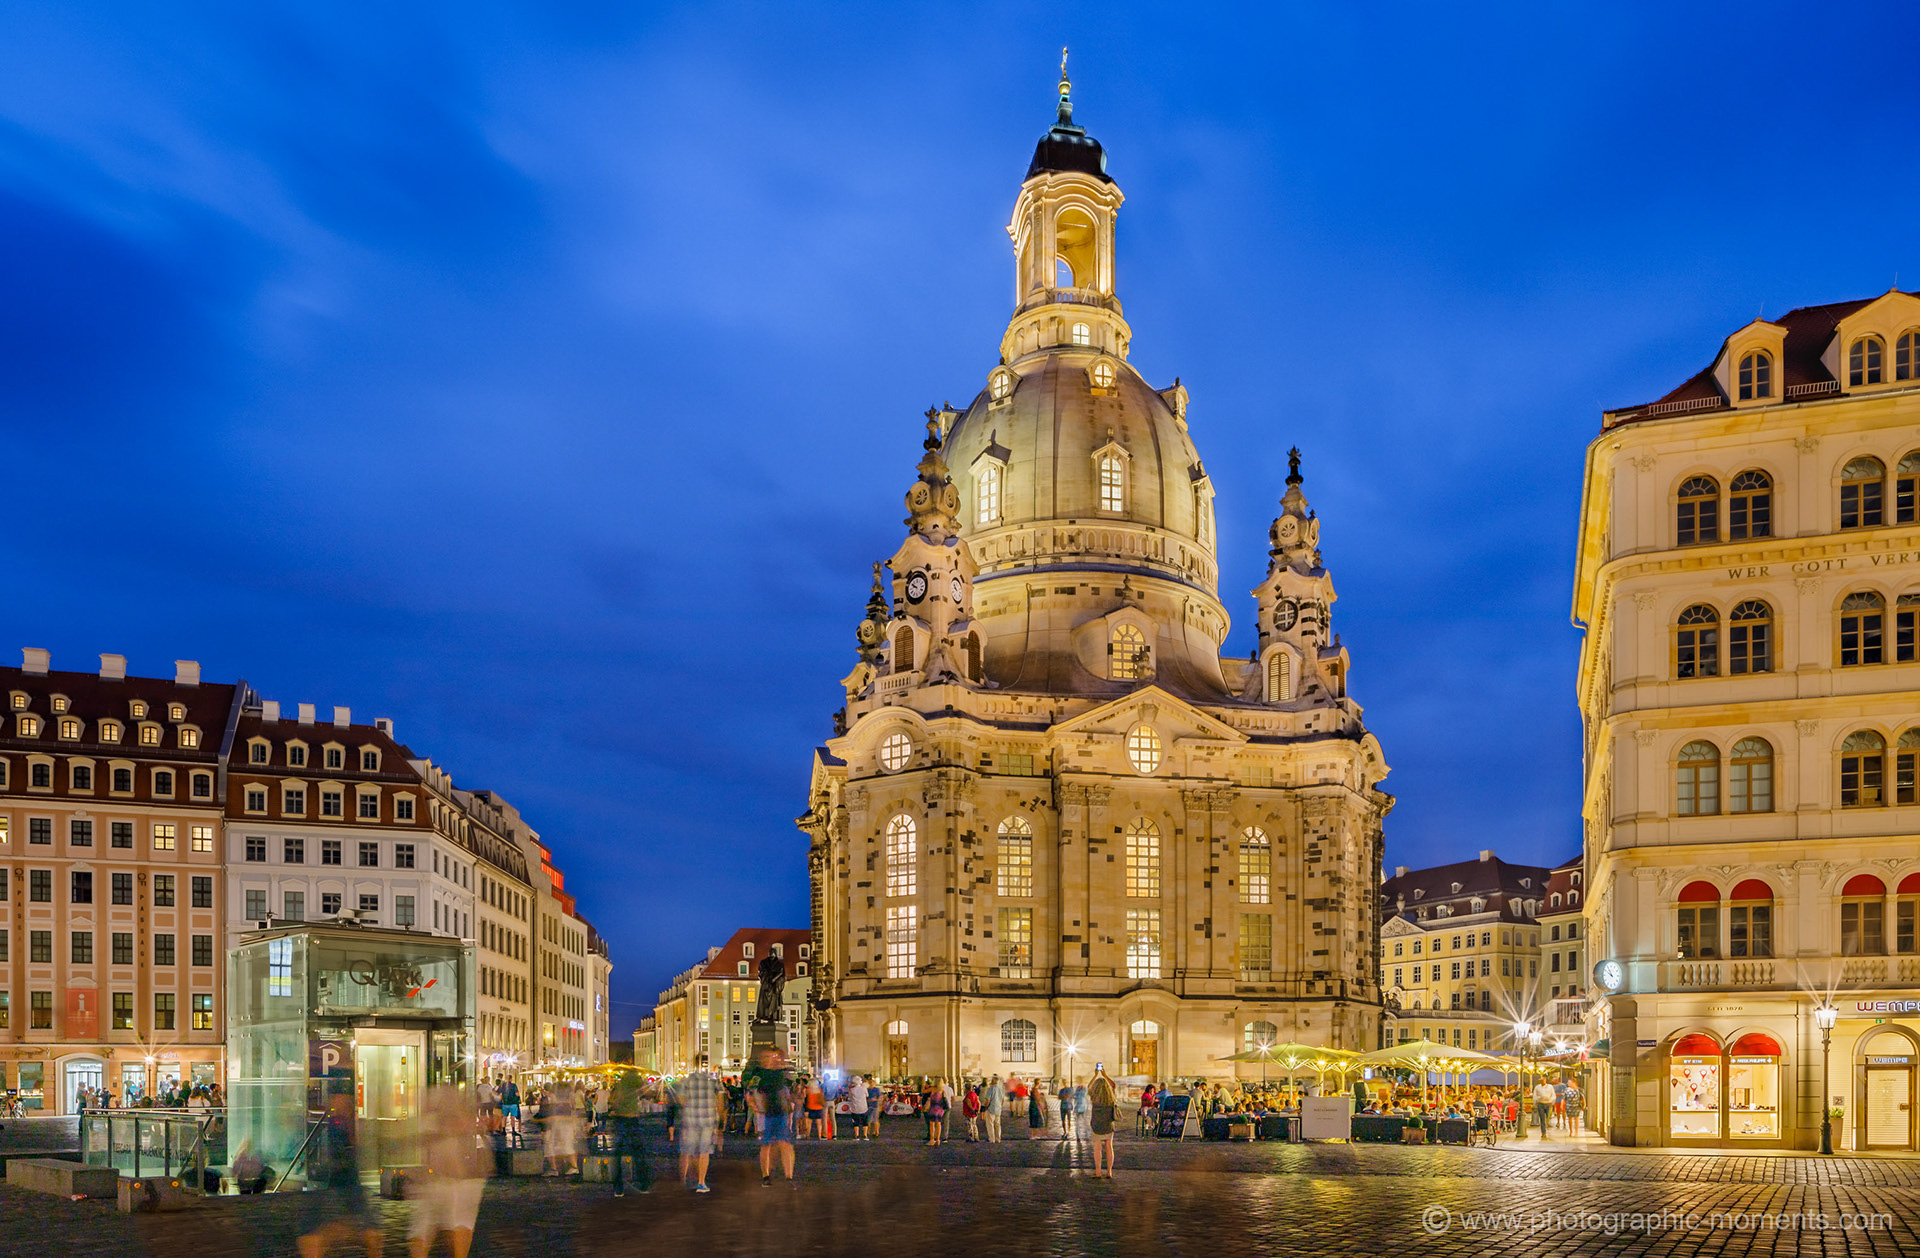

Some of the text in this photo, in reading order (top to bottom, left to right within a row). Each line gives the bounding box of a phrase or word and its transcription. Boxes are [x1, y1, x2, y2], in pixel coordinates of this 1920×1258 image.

[1728, 566, 1770, 579] WER
[1792, 558, 1848, 574] GOTT
[1856, 1001, 1920, 1012] WEMP
[322, 1048, 340, 1075] P
